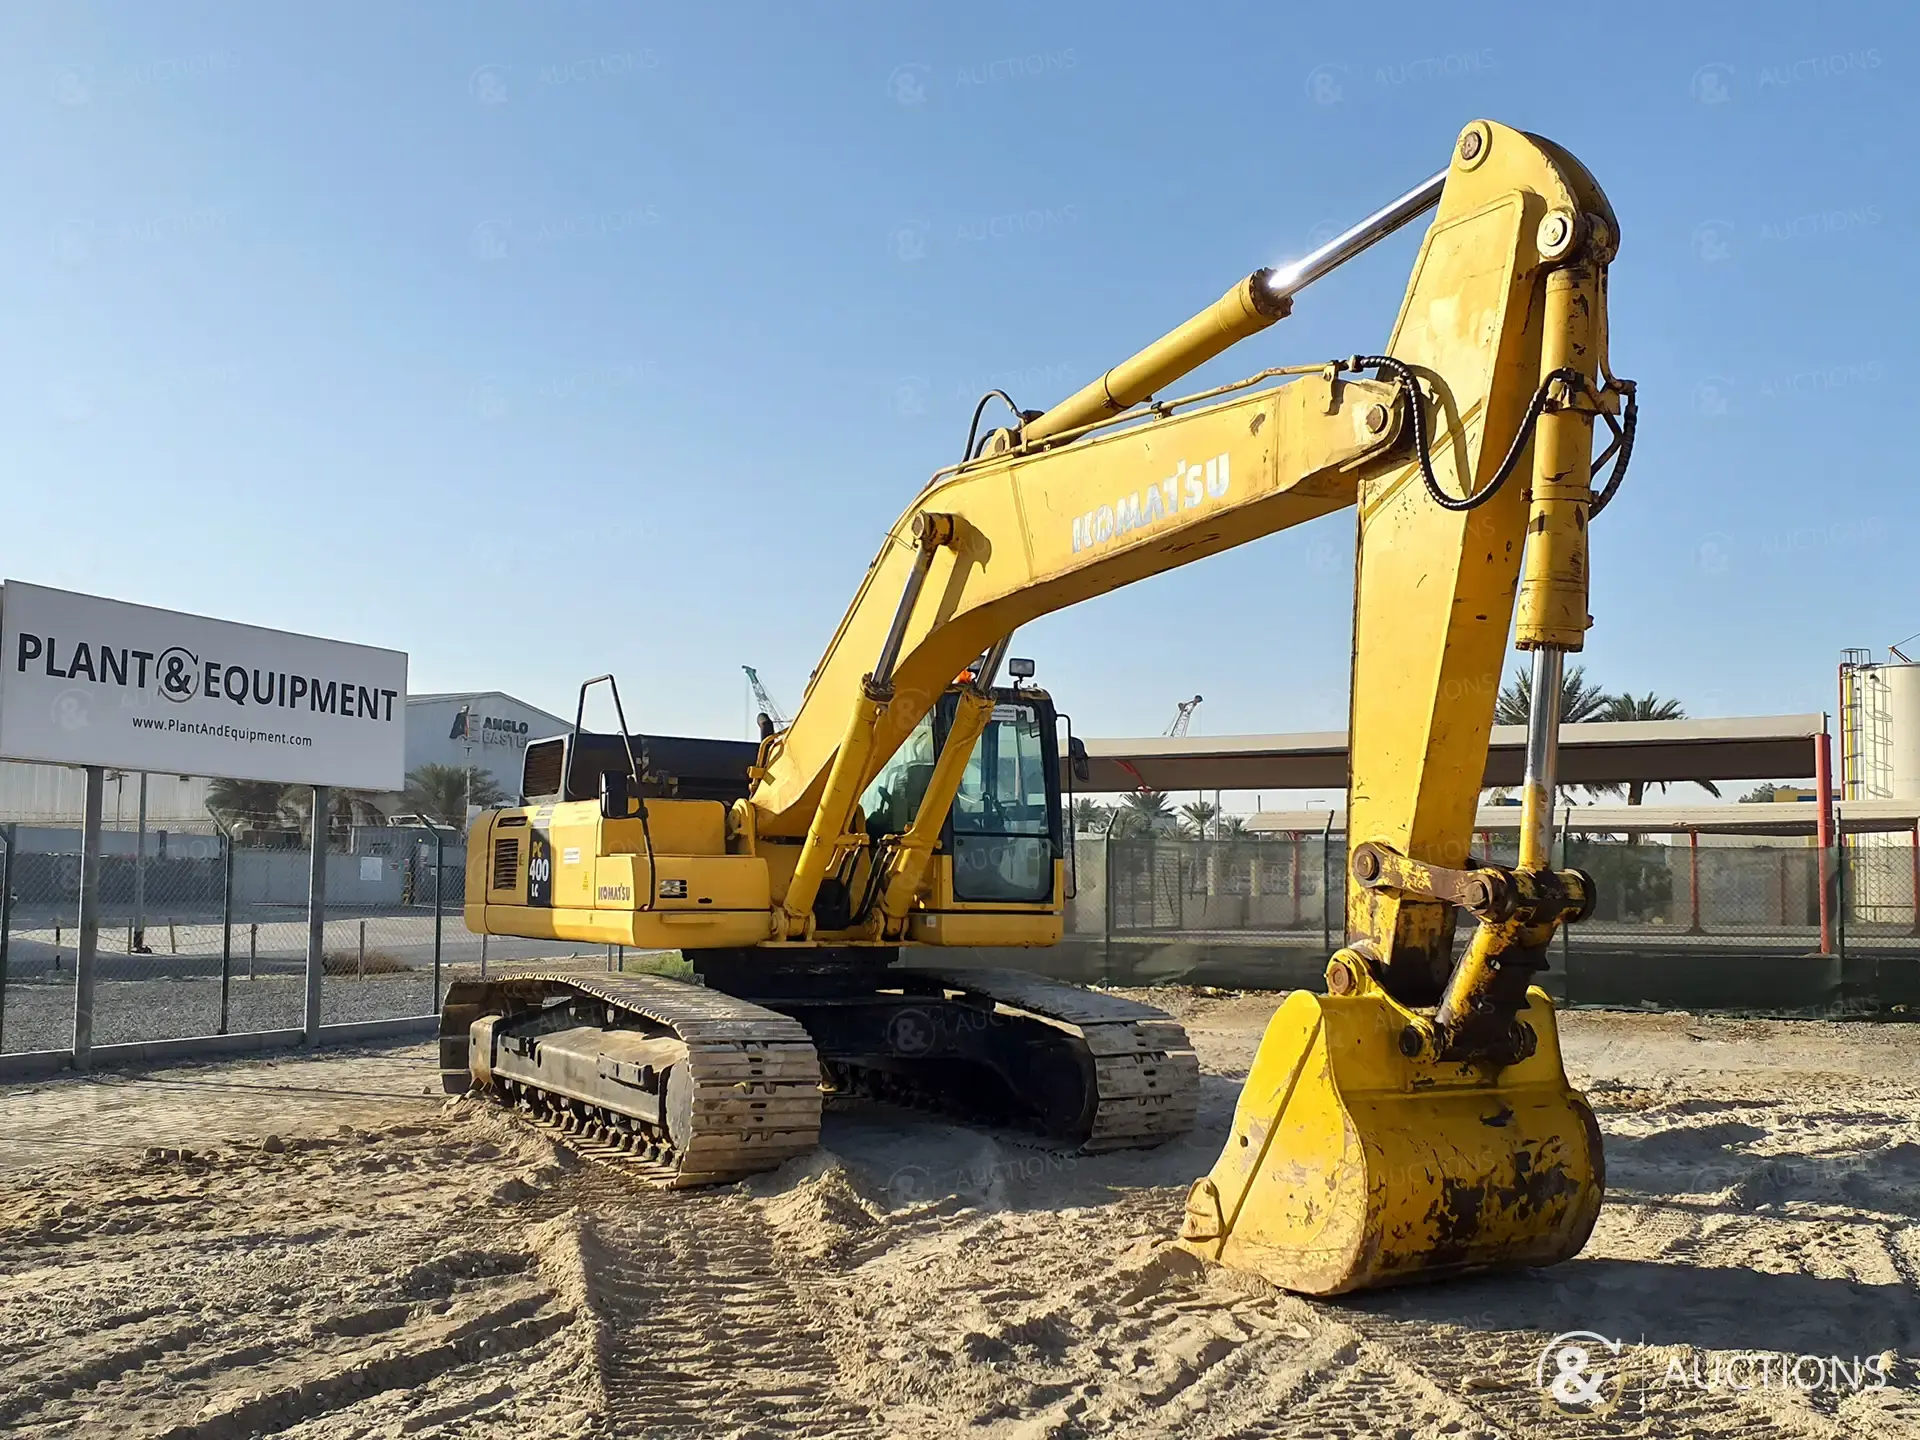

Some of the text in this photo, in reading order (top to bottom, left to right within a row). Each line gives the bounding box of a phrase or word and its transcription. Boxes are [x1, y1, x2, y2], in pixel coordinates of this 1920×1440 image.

[1072, 452, 1230, 553] KOMATSU
[132, 716, 313, 747] www.PlantAndEquipment.com
[483, 716, 529, 734] ANGLO
[483, 730, 529, 749] EASTE
[532, 841, 543, 858] PC
[529, 858, 550, 882] 400
[531, 883, 539, 898] LC
[598, 882, 631, 901] KOMATSU
